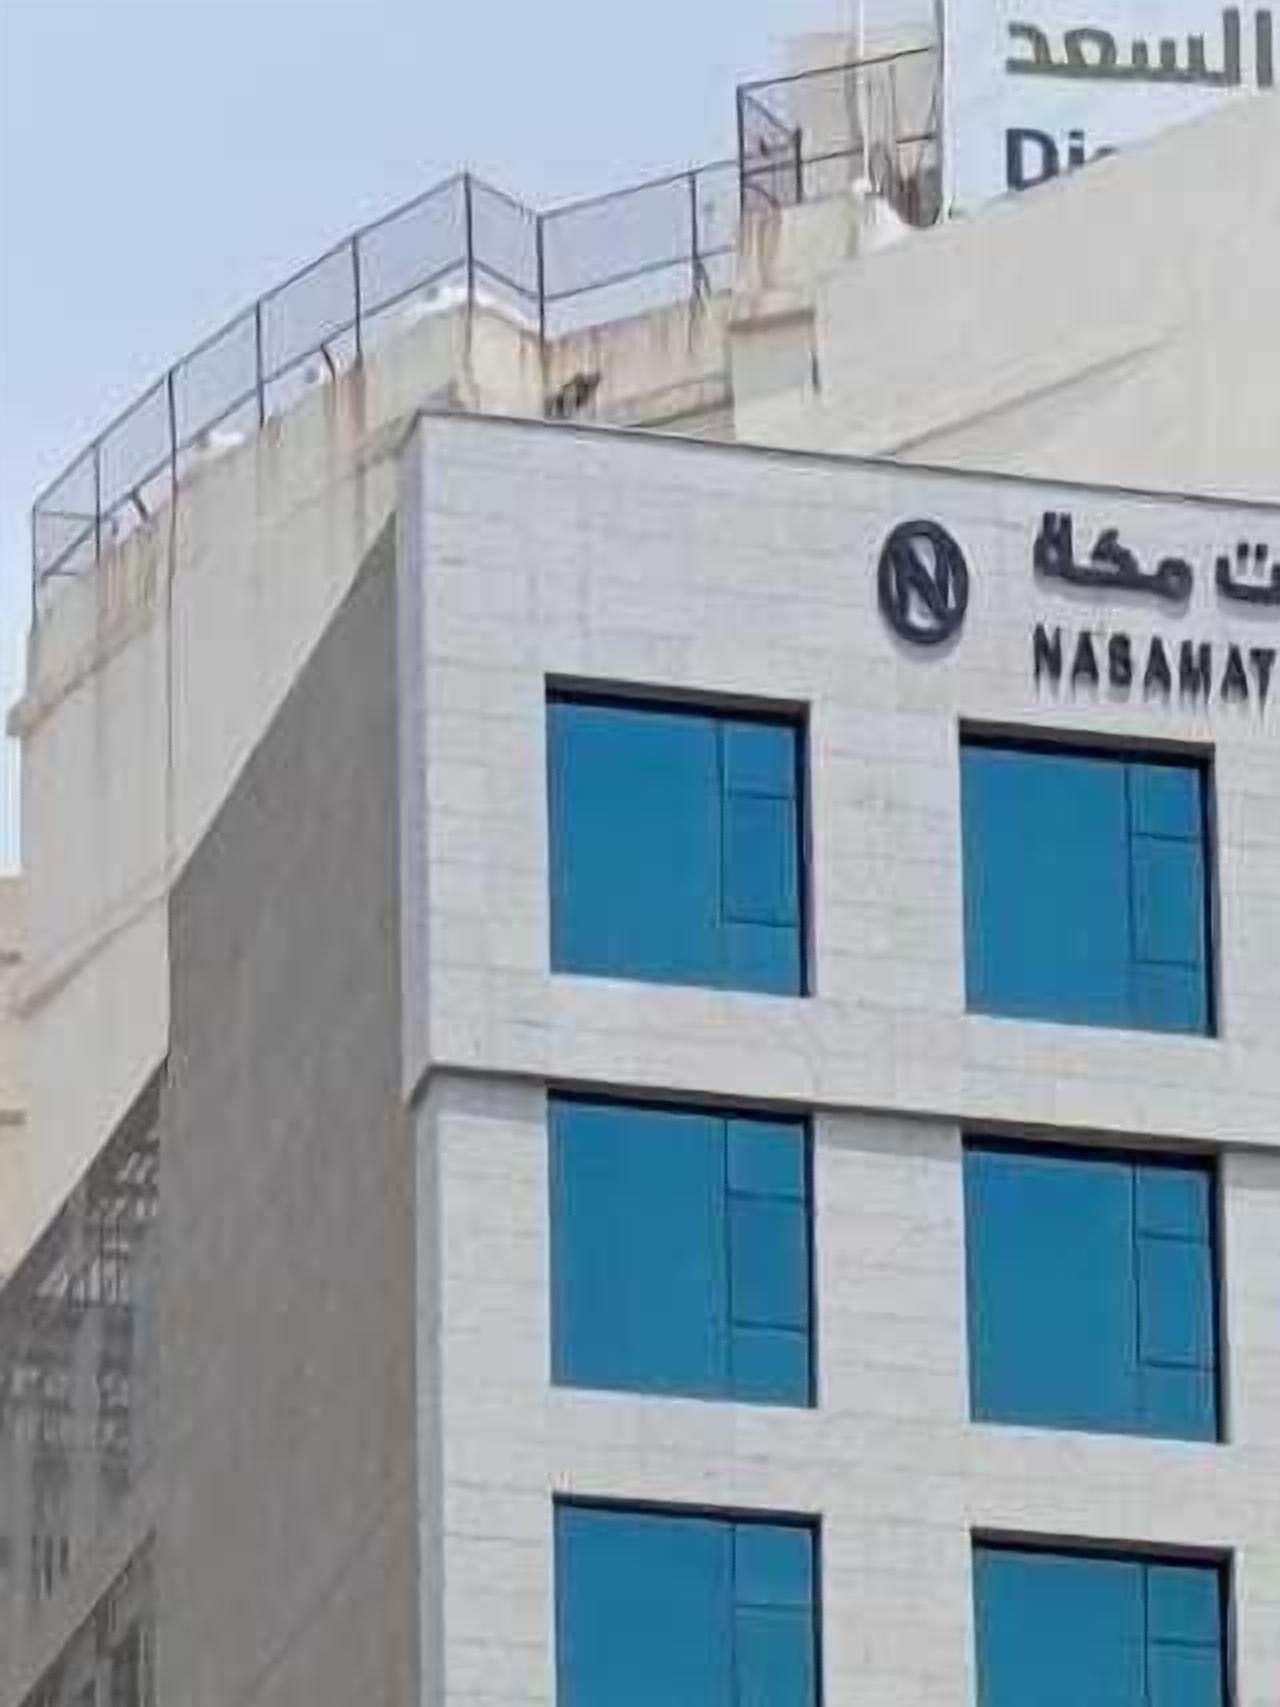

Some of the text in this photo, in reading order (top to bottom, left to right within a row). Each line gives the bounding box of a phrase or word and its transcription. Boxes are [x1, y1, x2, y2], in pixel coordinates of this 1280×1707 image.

[1006, 8, 1272, 88] السعد
[1006, 128, 1118, 191] Di
[1033, 511, 1193, 600] مكة
[1033, 622, 1277, 706] NASAMAT
